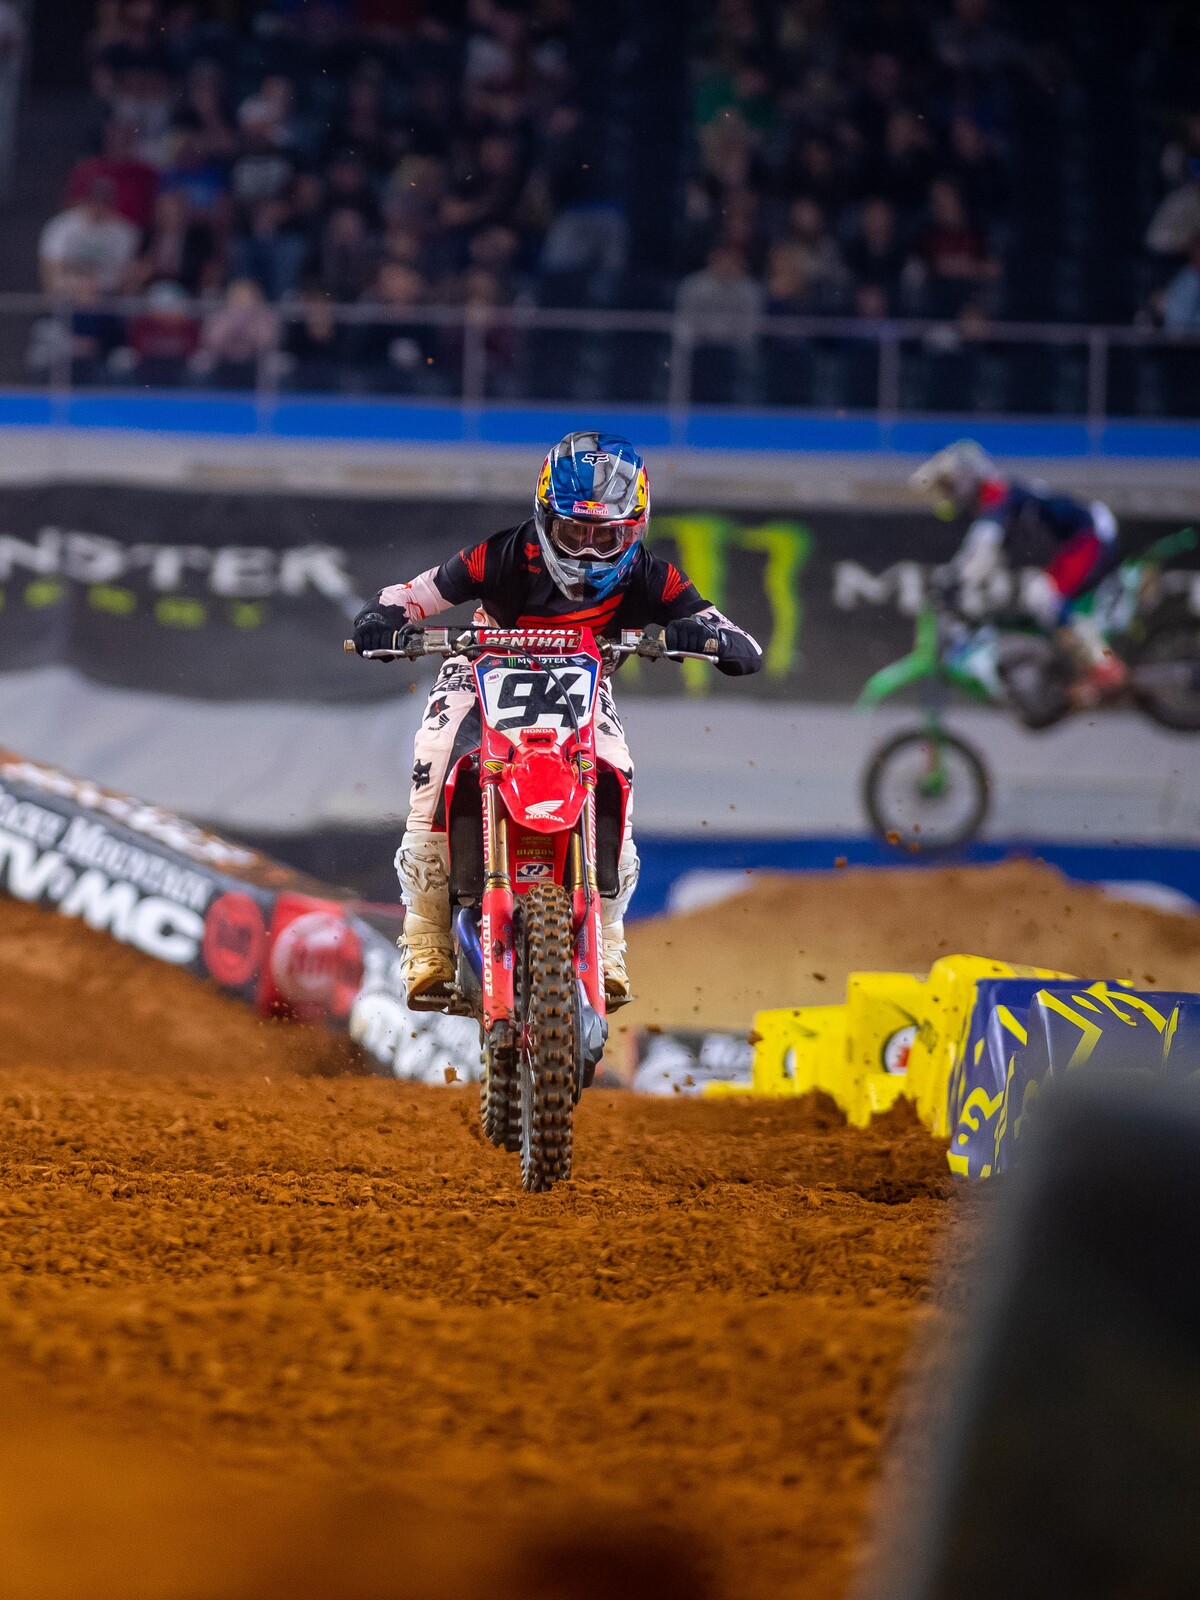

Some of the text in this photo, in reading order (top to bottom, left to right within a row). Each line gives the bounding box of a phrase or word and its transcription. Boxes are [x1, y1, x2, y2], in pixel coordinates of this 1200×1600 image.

[517, 656, 568, 665] MSTER
[494, 672, 587, 731] 94
[525, 813, 566, 823] HONDA
[482, 913, 493, 997] DUNLOP
